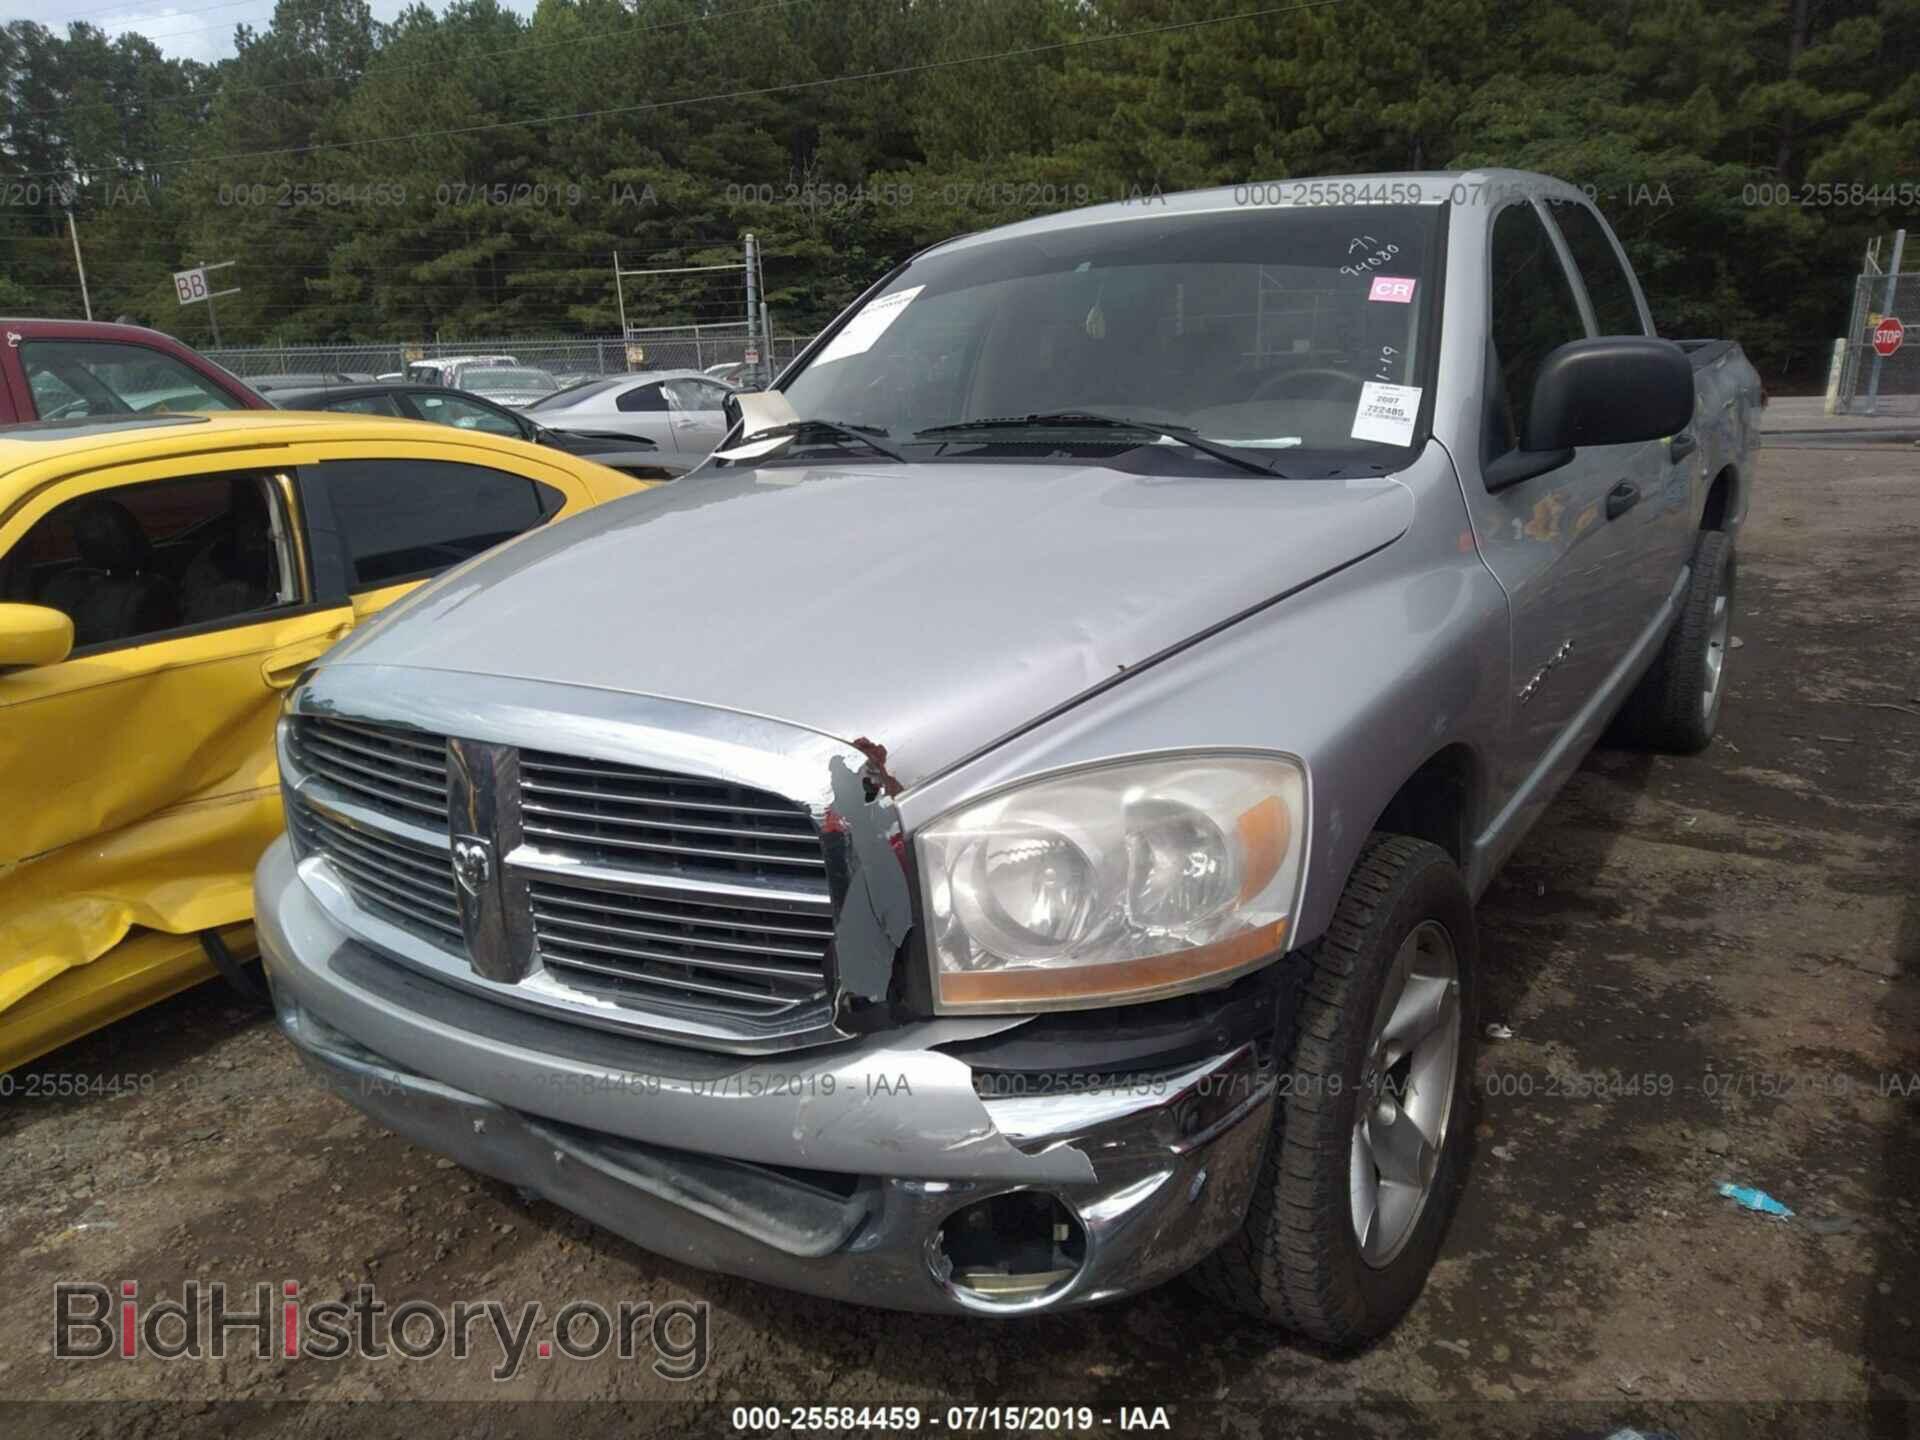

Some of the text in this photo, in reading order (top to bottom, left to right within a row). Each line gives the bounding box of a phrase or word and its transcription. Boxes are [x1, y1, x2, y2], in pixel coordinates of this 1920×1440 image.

[1340, 244, 1399, 276] 94080
[177, 274, 205, 301] BB
[1375, 282, 1409, 296] CR
[1875, 329, 1901, 344] STOP
